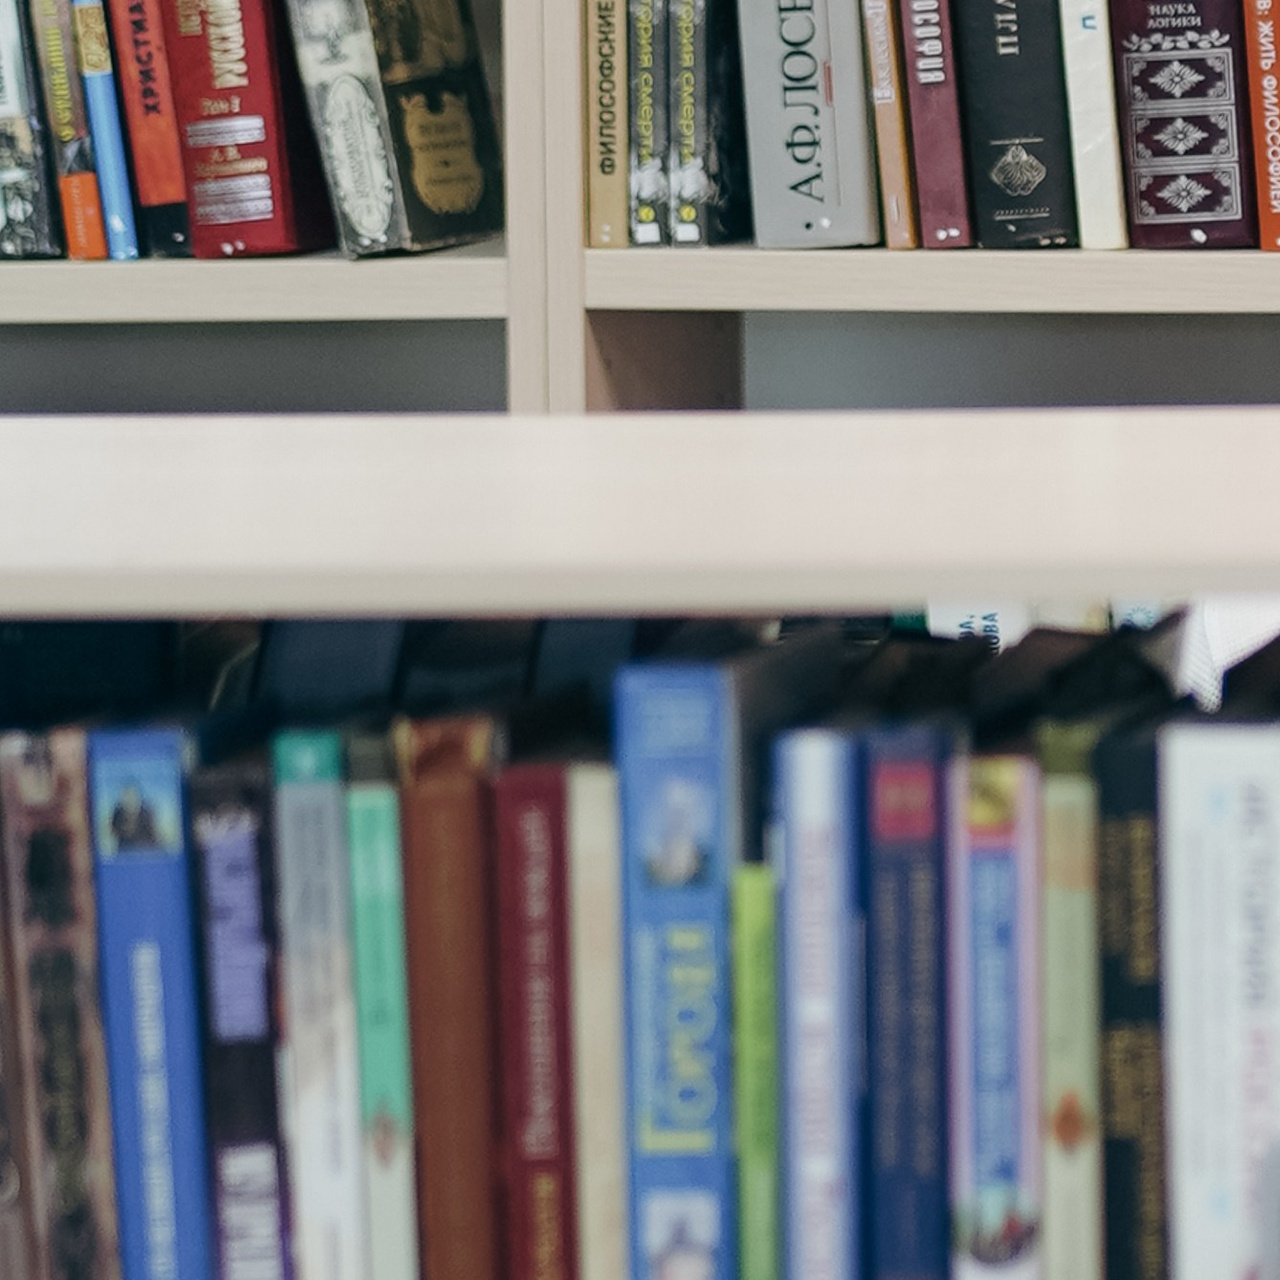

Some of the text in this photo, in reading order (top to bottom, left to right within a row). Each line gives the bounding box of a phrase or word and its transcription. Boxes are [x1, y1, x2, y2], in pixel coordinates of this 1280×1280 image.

[1147, 16, 1202, 29] ЛОГИКИ
[1150, 2, 1197, 17] НАУКА
[1254, 20, 1275, 71] ЖИТЬ
[596, 0, 618, 176] ФИЛОСОФСКИЕ
[636, 72, 656, 164] смерти
[676, 72, 696, 164] смерти
[783, 124, 826, 203] А.Ф.
